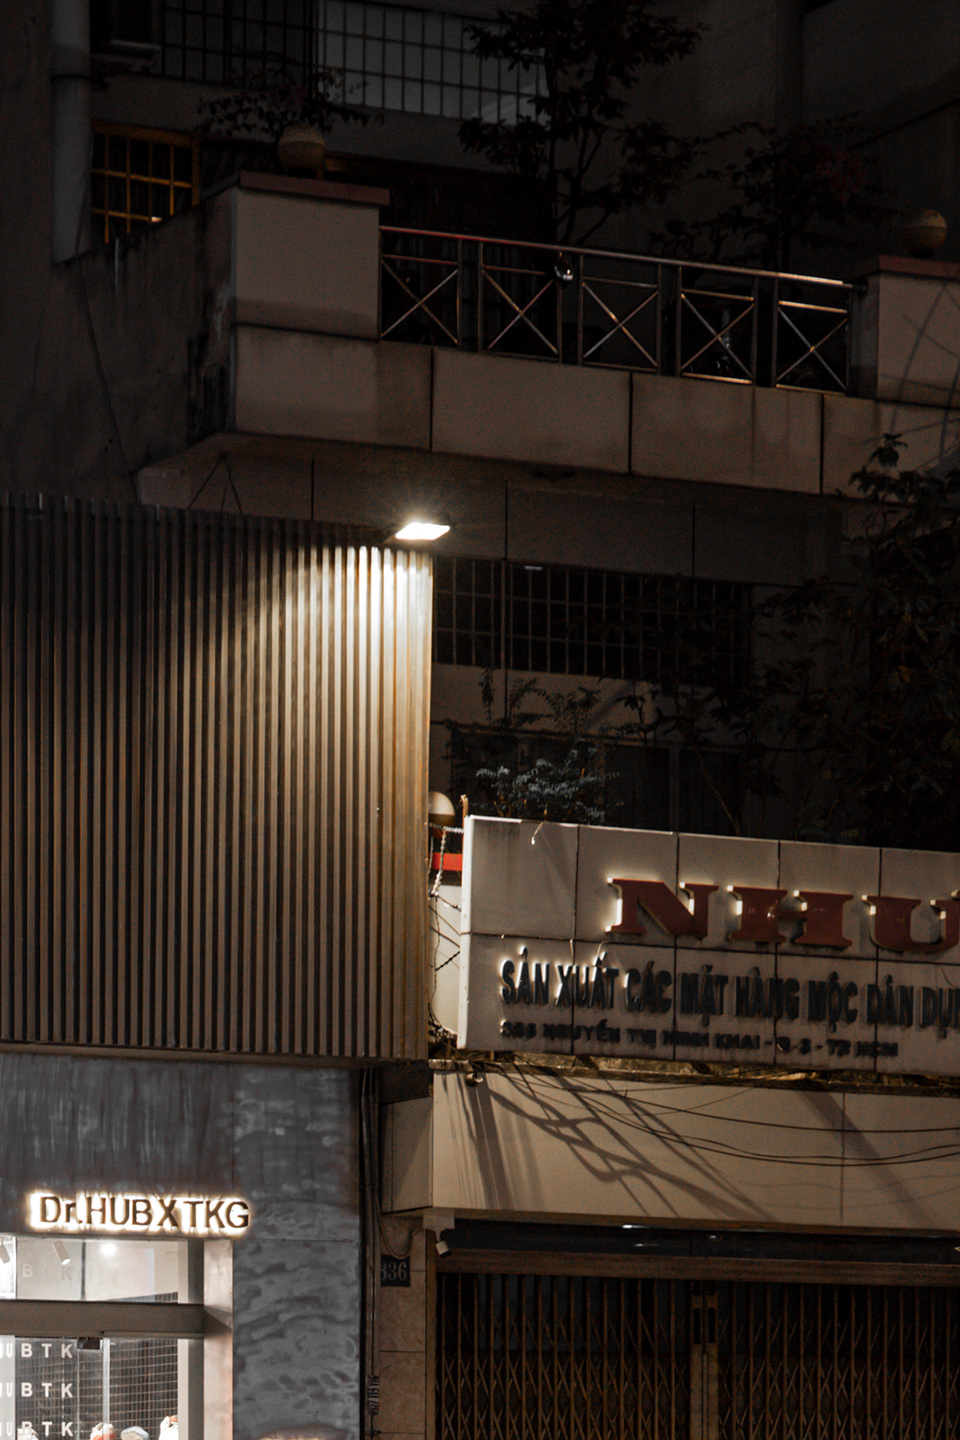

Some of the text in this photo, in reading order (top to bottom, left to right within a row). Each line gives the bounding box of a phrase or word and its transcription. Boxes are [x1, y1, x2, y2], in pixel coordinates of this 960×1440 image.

[500, 946, 550, 1005] SẢN
[555, 951, 619, 1009] XUẤT
[625, 960, 672, 1014] CÁC
[806, 971, 858, 1032] MỘC
[866, 974, 914, 1027] DÂN
